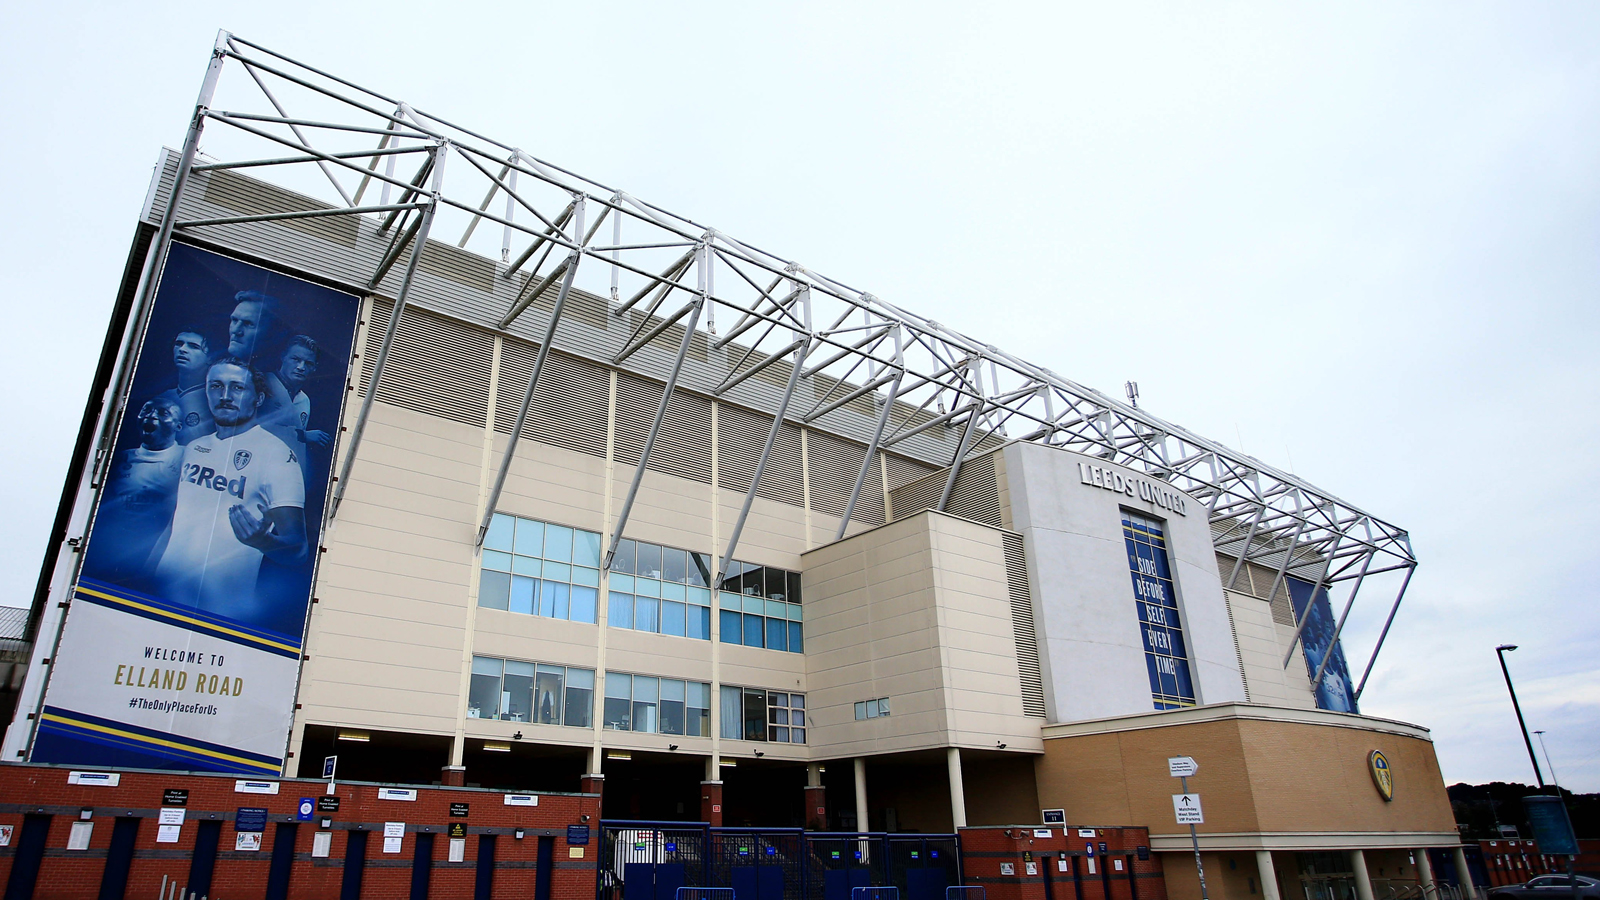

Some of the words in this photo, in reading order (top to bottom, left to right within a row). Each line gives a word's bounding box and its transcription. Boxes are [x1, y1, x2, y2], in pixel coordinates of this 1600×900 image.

[1078, 463, 1135, 498] LEEDS
[1137, 479, 1186, 517] UNITED
[1136, 579, 1165, 600] BEFORE
[1147, 630, 1171, 649] EVERY
[144, 646, 204, 665] WELCOME
[211, 654, 225, 667] TO
[114, 664, 188, 691] ELLAND
[195, 673, 243, 697] ROAD
[129, 697, 218, 716] #TheOnlyPlaceForUs
